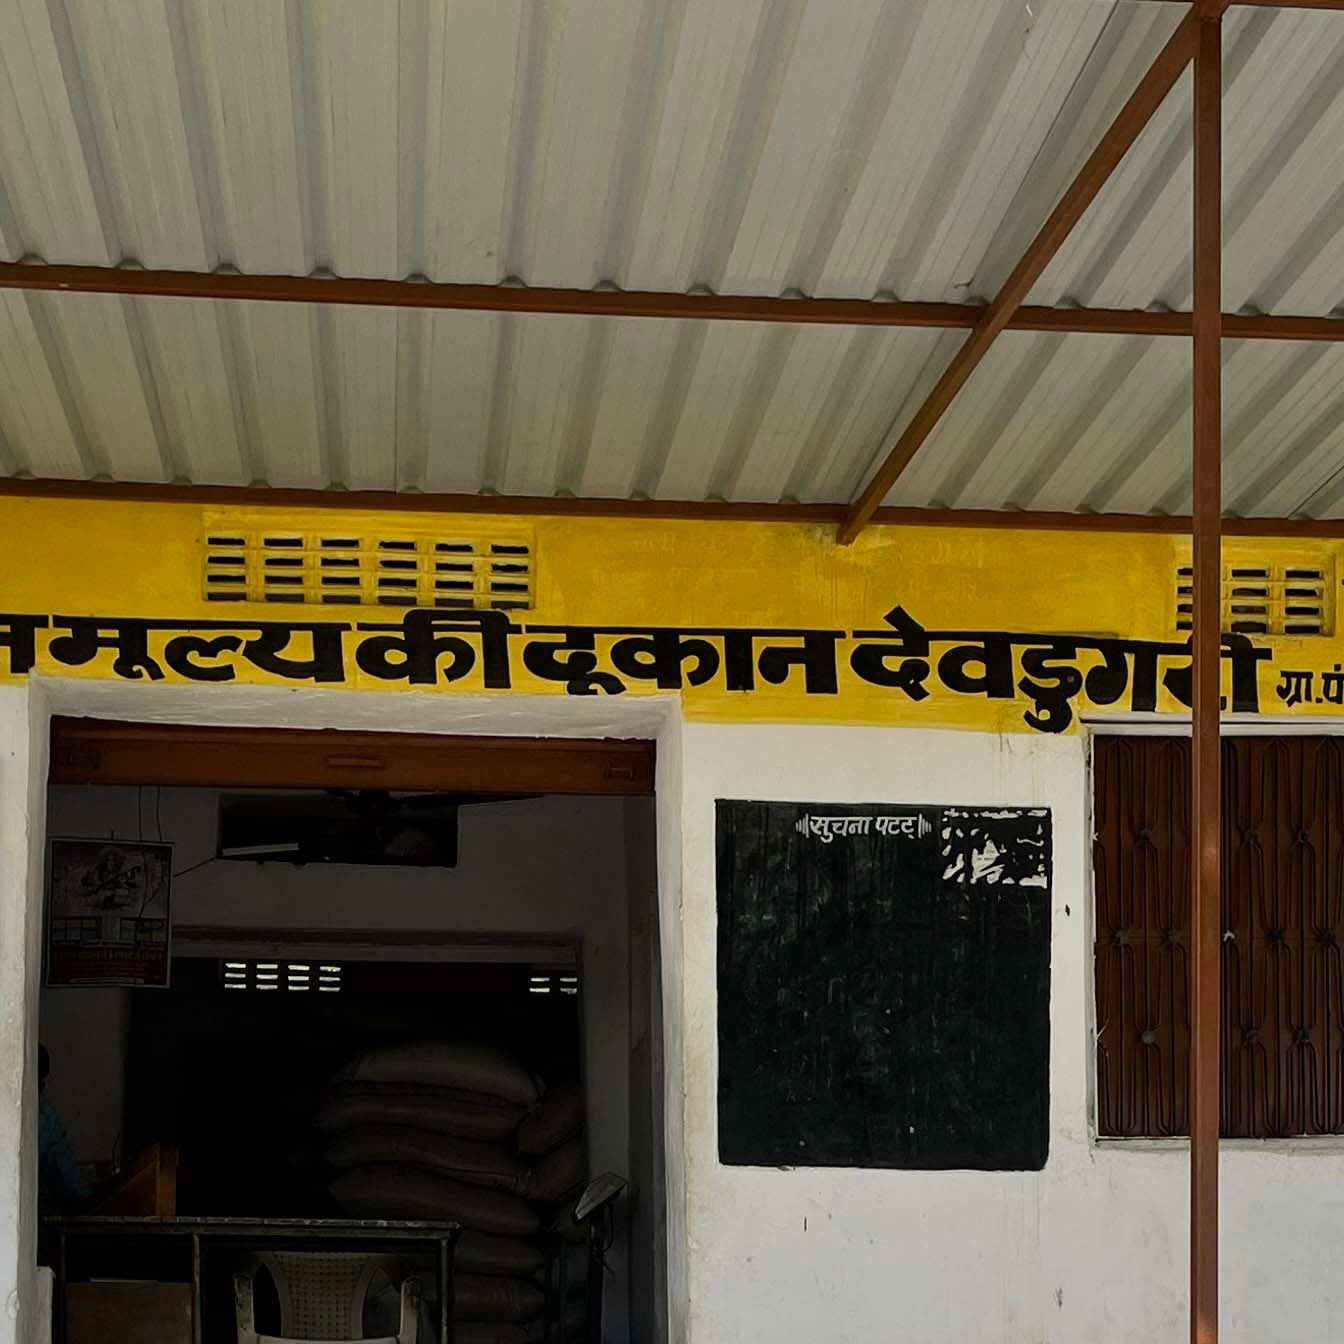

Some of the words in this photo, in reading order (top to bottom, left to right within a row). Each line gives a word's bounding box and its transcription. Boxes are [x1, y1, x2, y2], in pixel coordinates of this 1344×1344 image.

[47, 614, 352, 683] मूल्य
[355, 608, 523, 689] की
[522, 624, 847, 696] दूकान
[809, 816, 873, 843] सुचना
